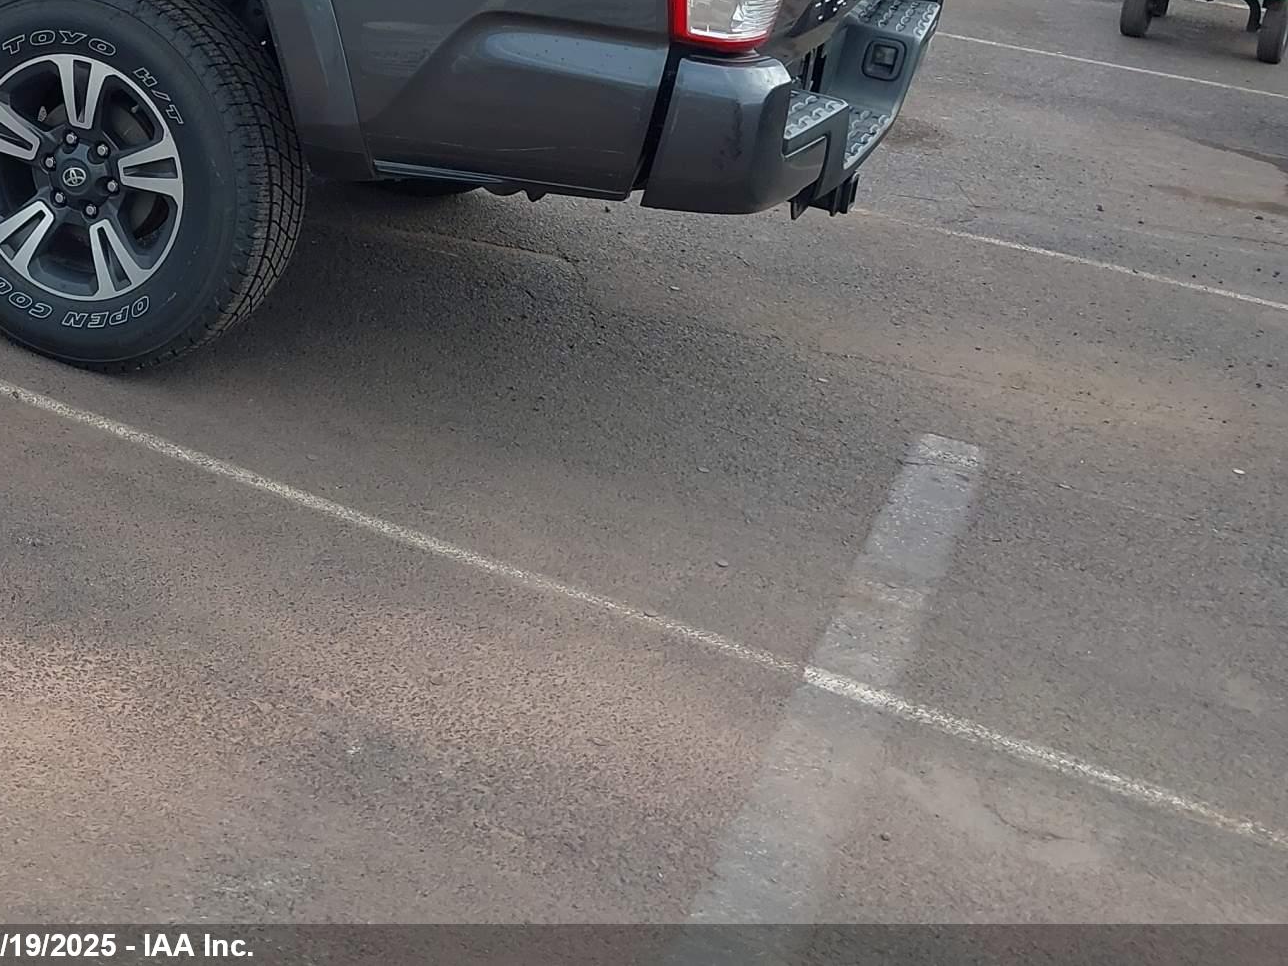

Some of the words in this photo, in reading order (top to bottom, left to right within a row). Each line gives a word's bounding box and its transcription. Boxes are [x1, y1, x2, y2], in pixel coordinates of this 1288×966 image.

[2, 30, 117, 56] TOYO
[133, 67, 184, 125] H/T
[62, 296, 150, 328] OPEN
